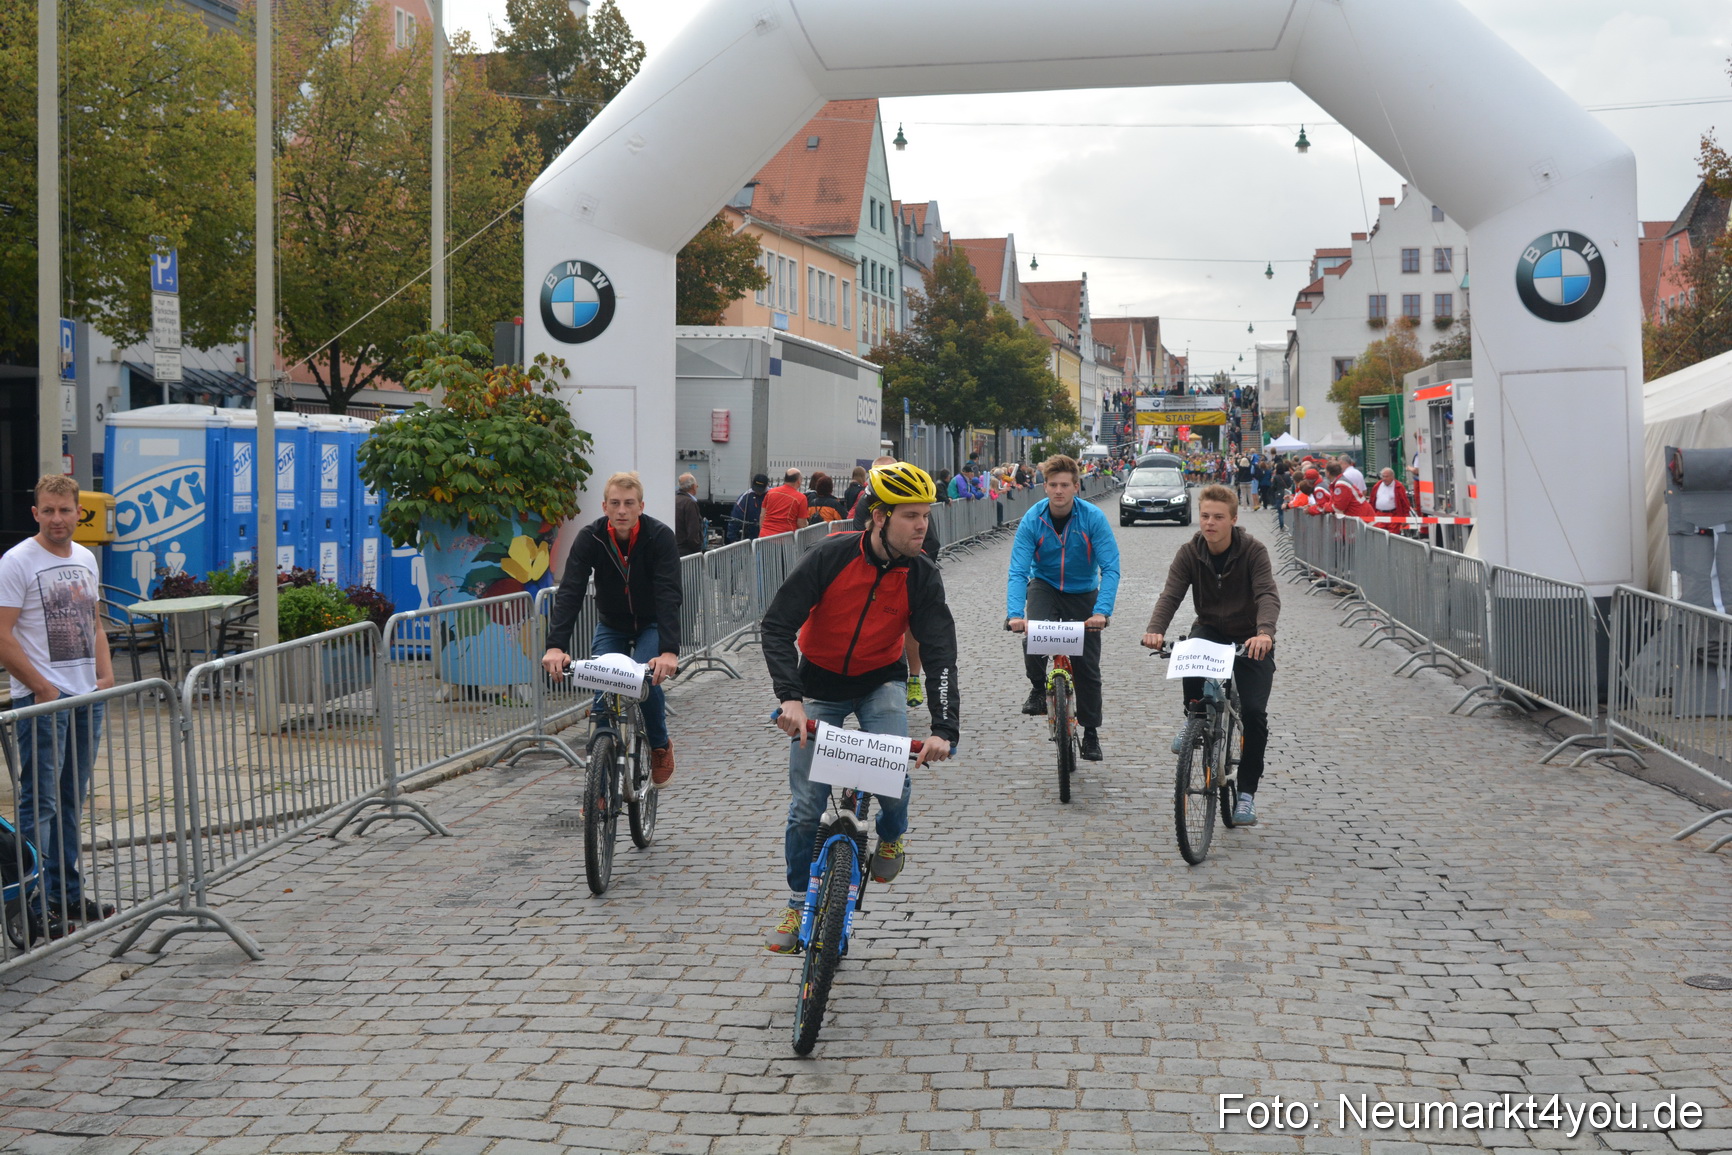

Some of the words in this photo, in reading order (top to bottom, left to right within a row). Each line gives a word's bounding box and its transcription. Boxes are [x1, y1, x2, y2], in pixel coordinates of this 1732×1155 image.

[1523, 232, 1599, 265] BMW
[545, 261, 609, 289] BMW
[96, 403, 104, 422] 3
[1165, 414, 1197, 422] START
[58, 570, 83, 581] JUST
[1033, 635, 1048, 643] 10,5
[1203, 654, 1225, 664] Mann
[584, 662, 610, 673] Erster
[612, 668, 635, 679] Mann
[1206, 664, 1226, 673] Lauf
[577, 673, 637, 691] Halbmarathon
[825, 730, 864, 747] Erster
[867, 739, 903, 755] Mann
[816, 744, 905, 772] Halbmarathon
